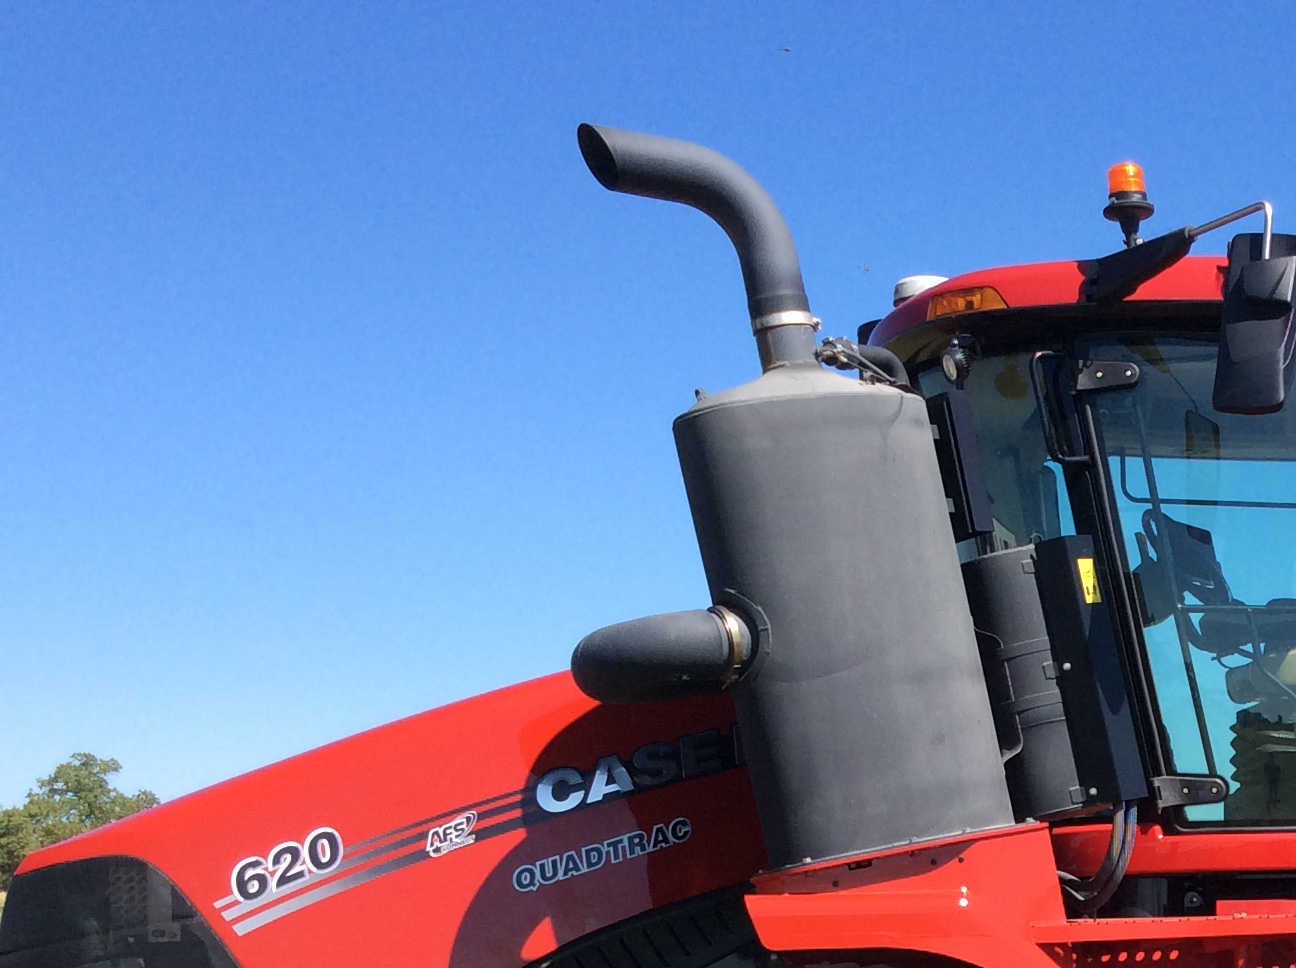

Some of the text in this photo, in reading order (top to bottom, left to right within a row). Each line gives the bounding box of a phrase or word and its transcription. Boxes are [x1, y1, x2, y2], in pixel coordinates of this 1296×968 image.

[536, 729, 721, 813] CASE
[230, 826, 344, 903] 620
[428, 819, 467, 849] AFS
[512, 817, 692, 892] QUADTRAC
